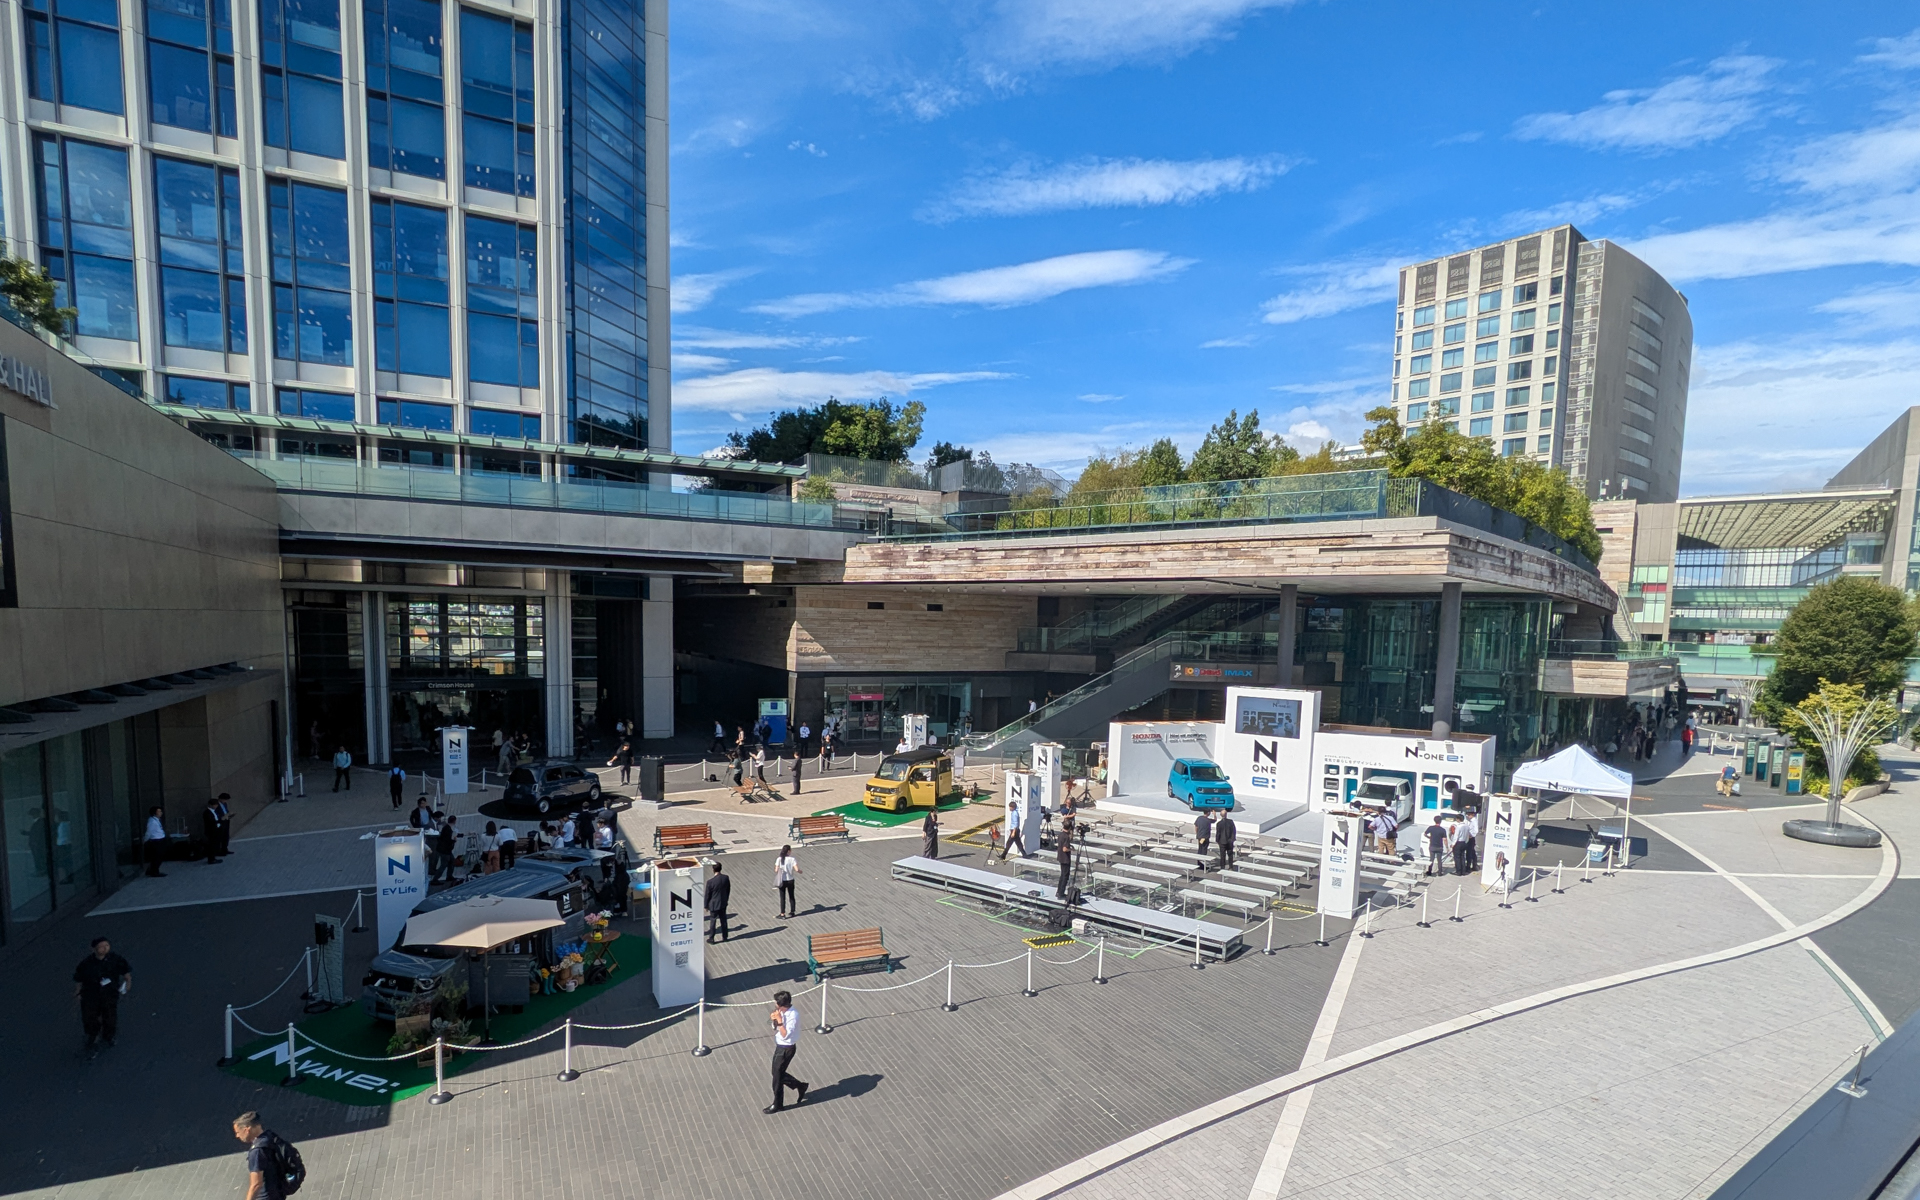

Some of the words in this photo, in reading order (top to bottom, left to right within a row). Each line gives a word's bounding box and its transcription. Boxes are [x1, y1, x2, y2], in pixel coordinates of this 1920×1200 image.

[13, 357, 59, 410] HALL
[449, 738, 461, 749] N
[1253, 739, 1278, 765] N
[1405, 746, 1444, 761] N-ONE
[1038, 755, 1048, 767] N
[1252, 764, 1277, 775] ONE
[1252, 776, 1276, 789] e:
[1011, 785, 1022, 799] N
[1495, 811, 1512, 827] N
[1494, 825, 1511, 833] ONE
[1331, 830, 1348, 848] N
[1329, 846, 1348, 855] ONE
[388, 855, 411, 876] N
[382, 887, 397, 896] EV
[398, 885, 418, 895] Life
[670, 888, 693, 912] N
[669, 911, 693, 920] ONE
[670, 922, 693, 934] e:
